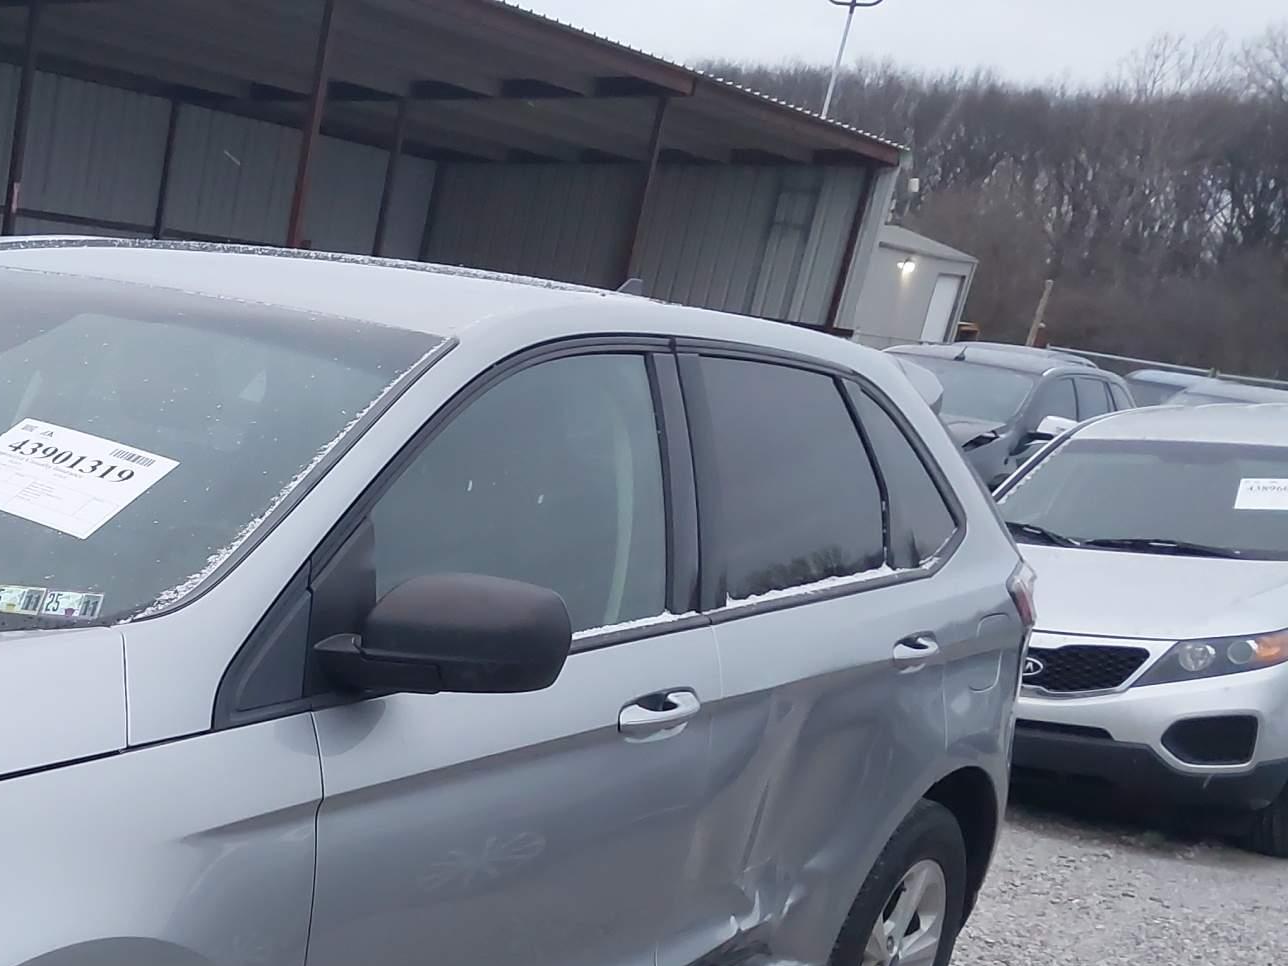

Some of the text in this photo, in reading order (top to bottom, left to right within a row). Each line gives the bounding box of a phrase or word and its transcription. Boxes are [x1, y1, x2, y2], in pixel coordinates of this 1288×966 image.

[8, 439, 135, 483] 43901319
[22, 594, 42, 611] 11
[45, 593, 63, 612] 25
[81, 599, 99, 617] 11
